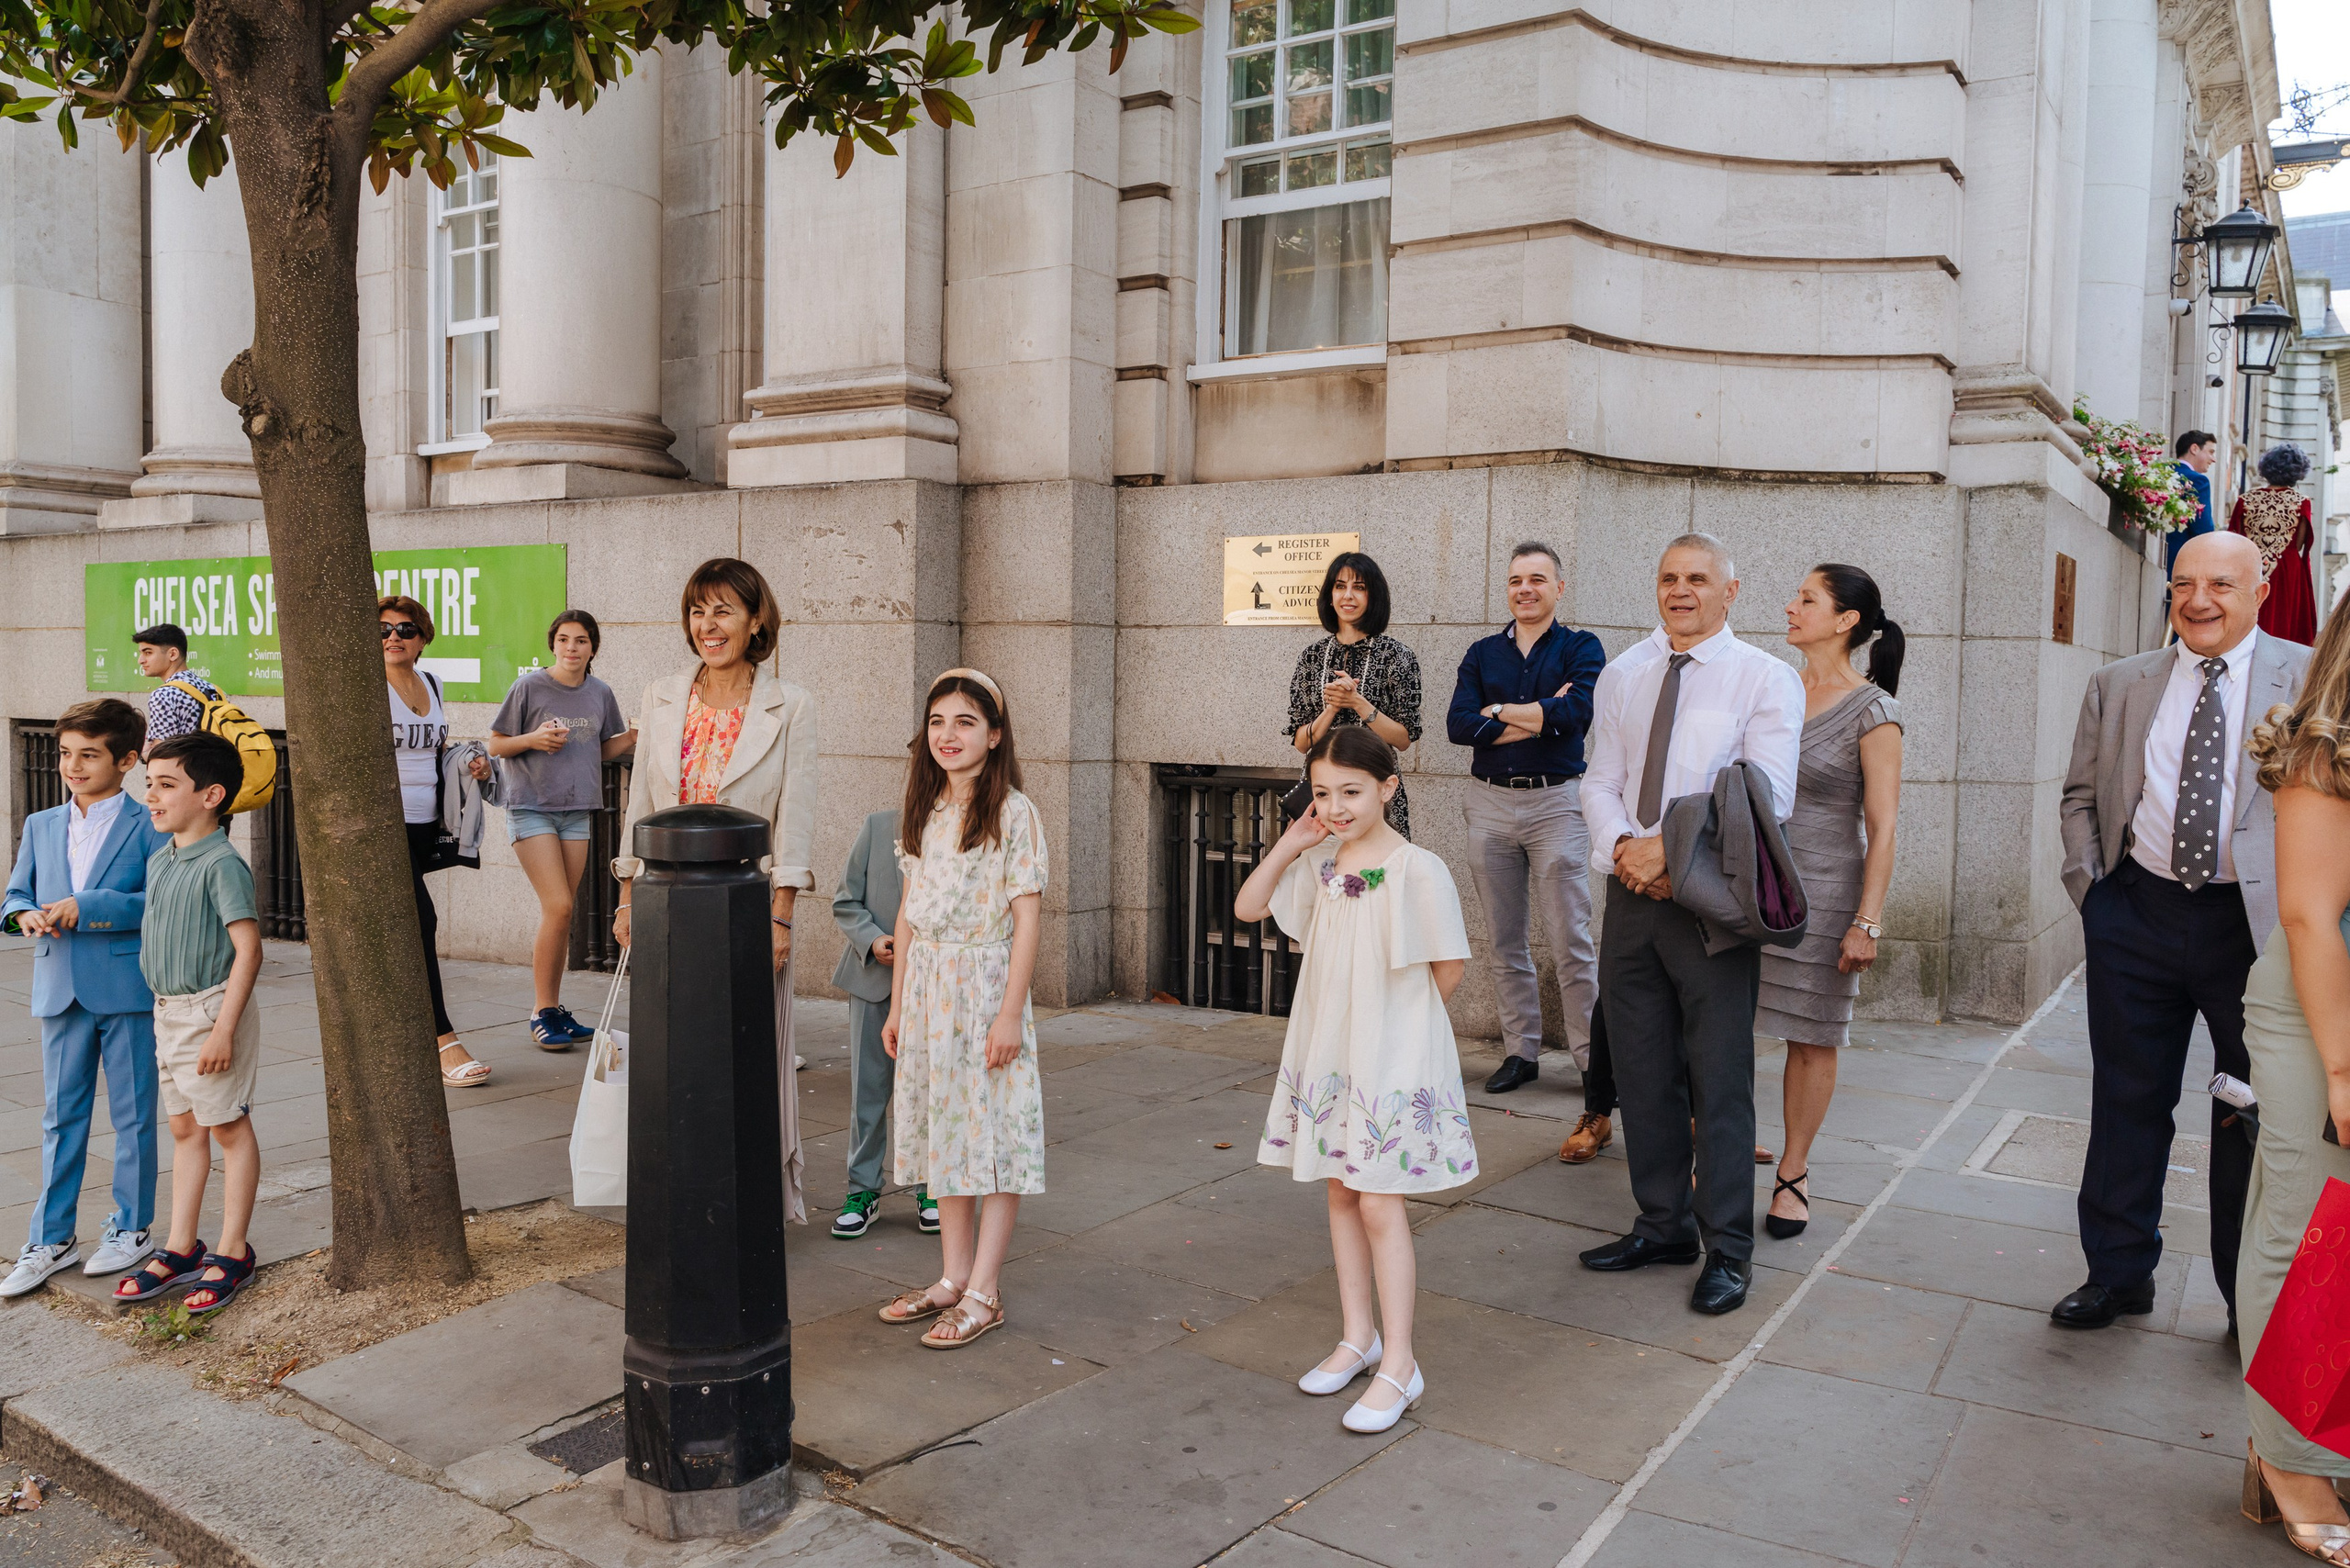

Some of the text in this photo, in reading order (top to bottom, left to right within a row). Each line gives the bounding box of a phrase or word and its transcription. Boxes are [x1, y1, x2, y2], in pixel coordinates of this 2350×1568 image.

[1278, 539, 1330, 548] REGISTER
[1284, 552, 1323, 561] OFFICE
[134, 575, 238, 635] CHELSEA
[254, 666, 270, 678] And
[392, 723, 449, 749] GUES
